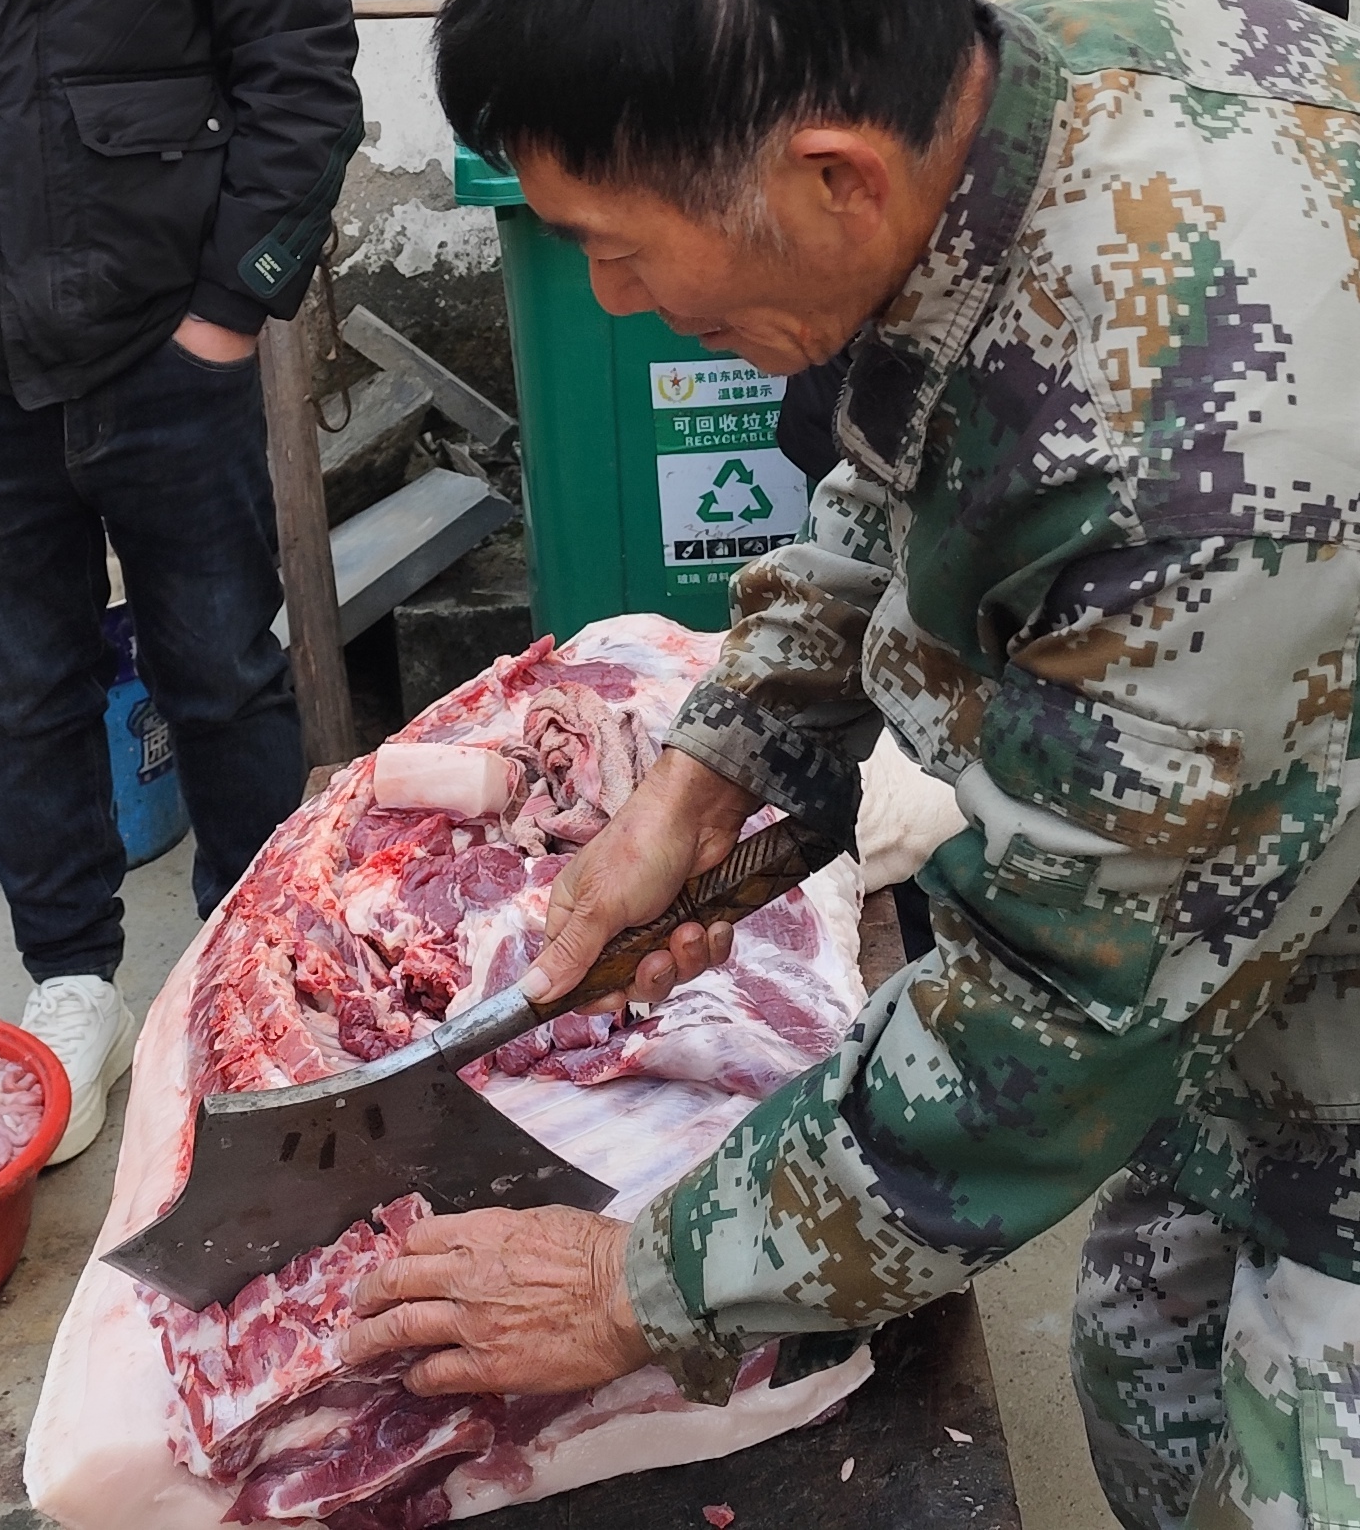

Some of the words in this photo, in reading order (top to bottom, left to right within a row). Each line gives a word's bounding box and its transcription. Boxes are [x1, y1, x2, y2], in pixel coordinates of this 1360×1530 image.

[717, 384, 773, 400] 温馨提示
[673, 410, 780, 435] 可回收垃圾
[685, 431, 774, 447] RECYCLABLE
